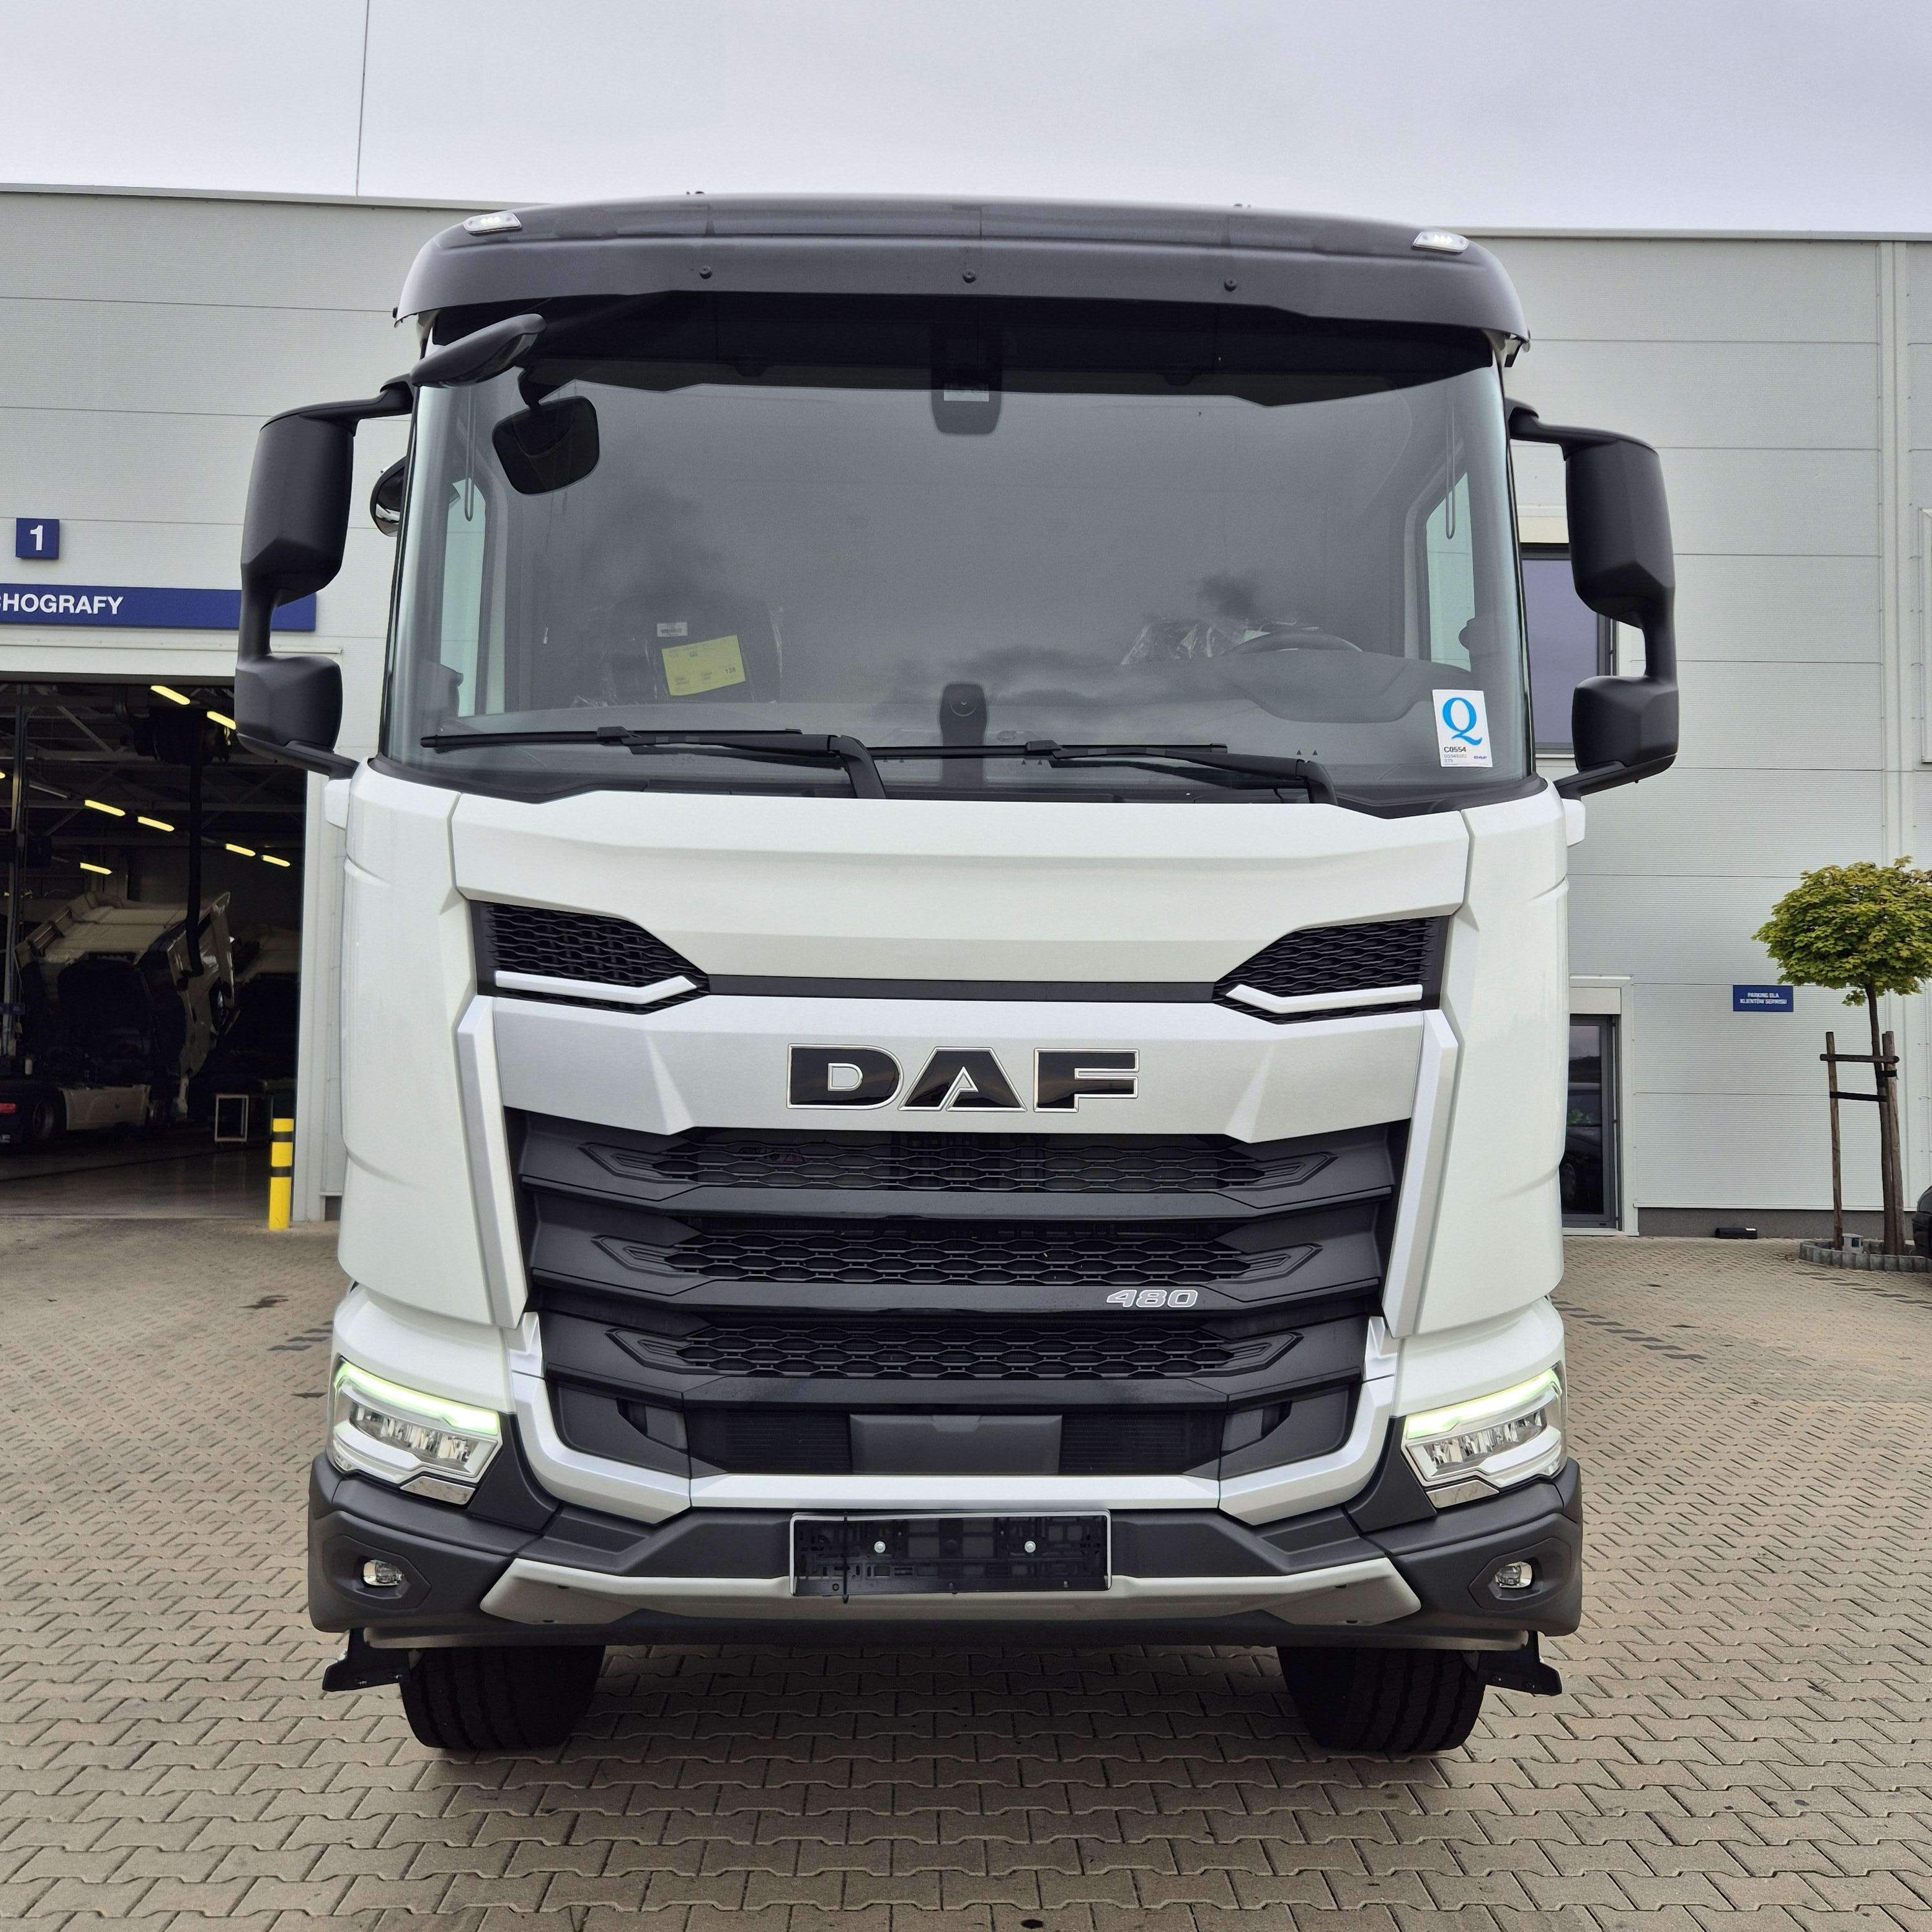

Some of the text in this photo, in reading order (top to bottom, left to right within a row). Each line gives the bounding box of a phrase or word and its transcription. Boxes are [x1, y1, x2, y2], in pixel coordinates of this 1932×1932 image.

[30, 525, 44, 551] 1
[0, 593, 123, 615] HOGRAFY
[1442, 697, 1483, 746] Q
[785, 1043, 1140, 1113] DAF
[1106, 1290, 1198, 1308] 480
